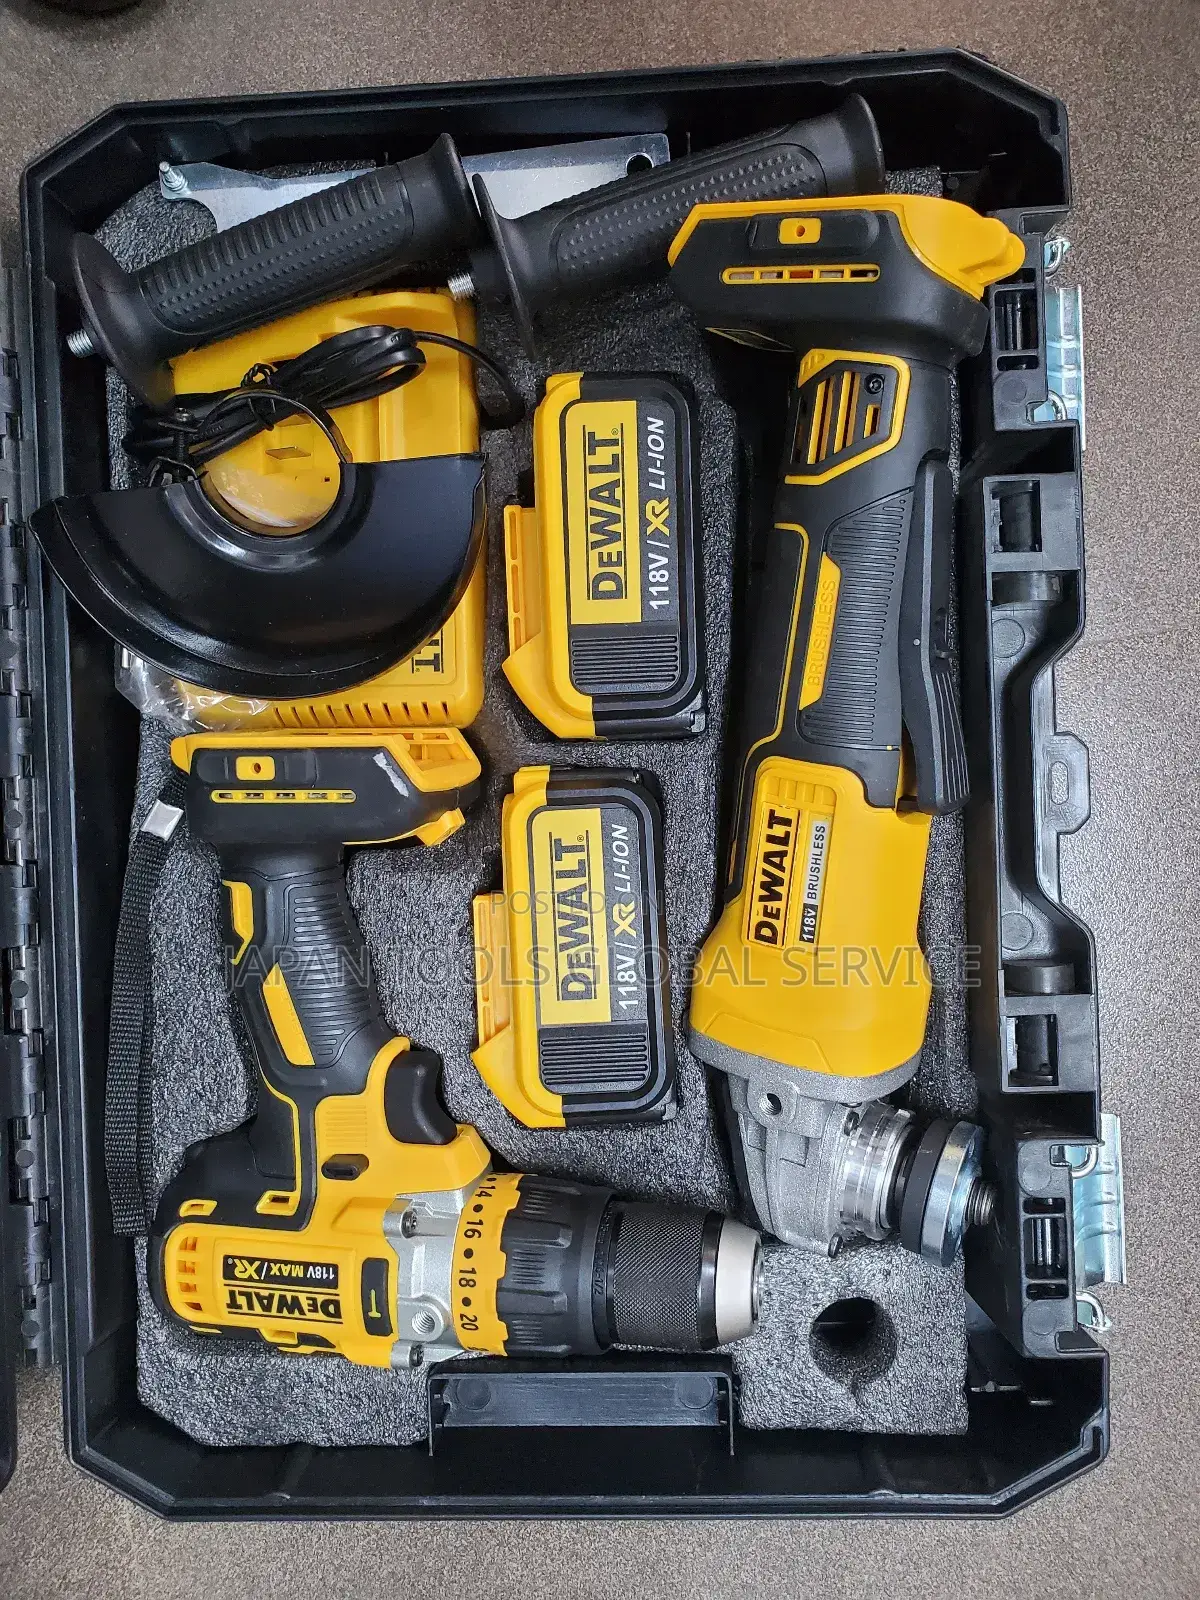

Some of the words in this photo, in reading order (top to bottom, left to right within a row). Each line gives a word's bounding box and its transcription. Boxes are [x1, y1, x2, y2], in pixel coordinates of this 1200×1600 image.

[646, 416, 665, 491] LI-ION
[806, 580, 836, 686] BRUSHLESS
[611, 823, 631, 893] LI-ION
[807, 825, 826, 901] BRUSHLESS
[754, 809, 793, 946] DEWALT
[802, 908, 816, 941] 118V
[475, 1185, 496, 1198] 14
[463, 1219, 484, 1239] 16
[306, 1265, 335, 1280] 118V
[458, 1267, 477, 1288] 18
[226, 1289, 343, 1319] DEWALT
[459, 1313, 479, 1331] 20
